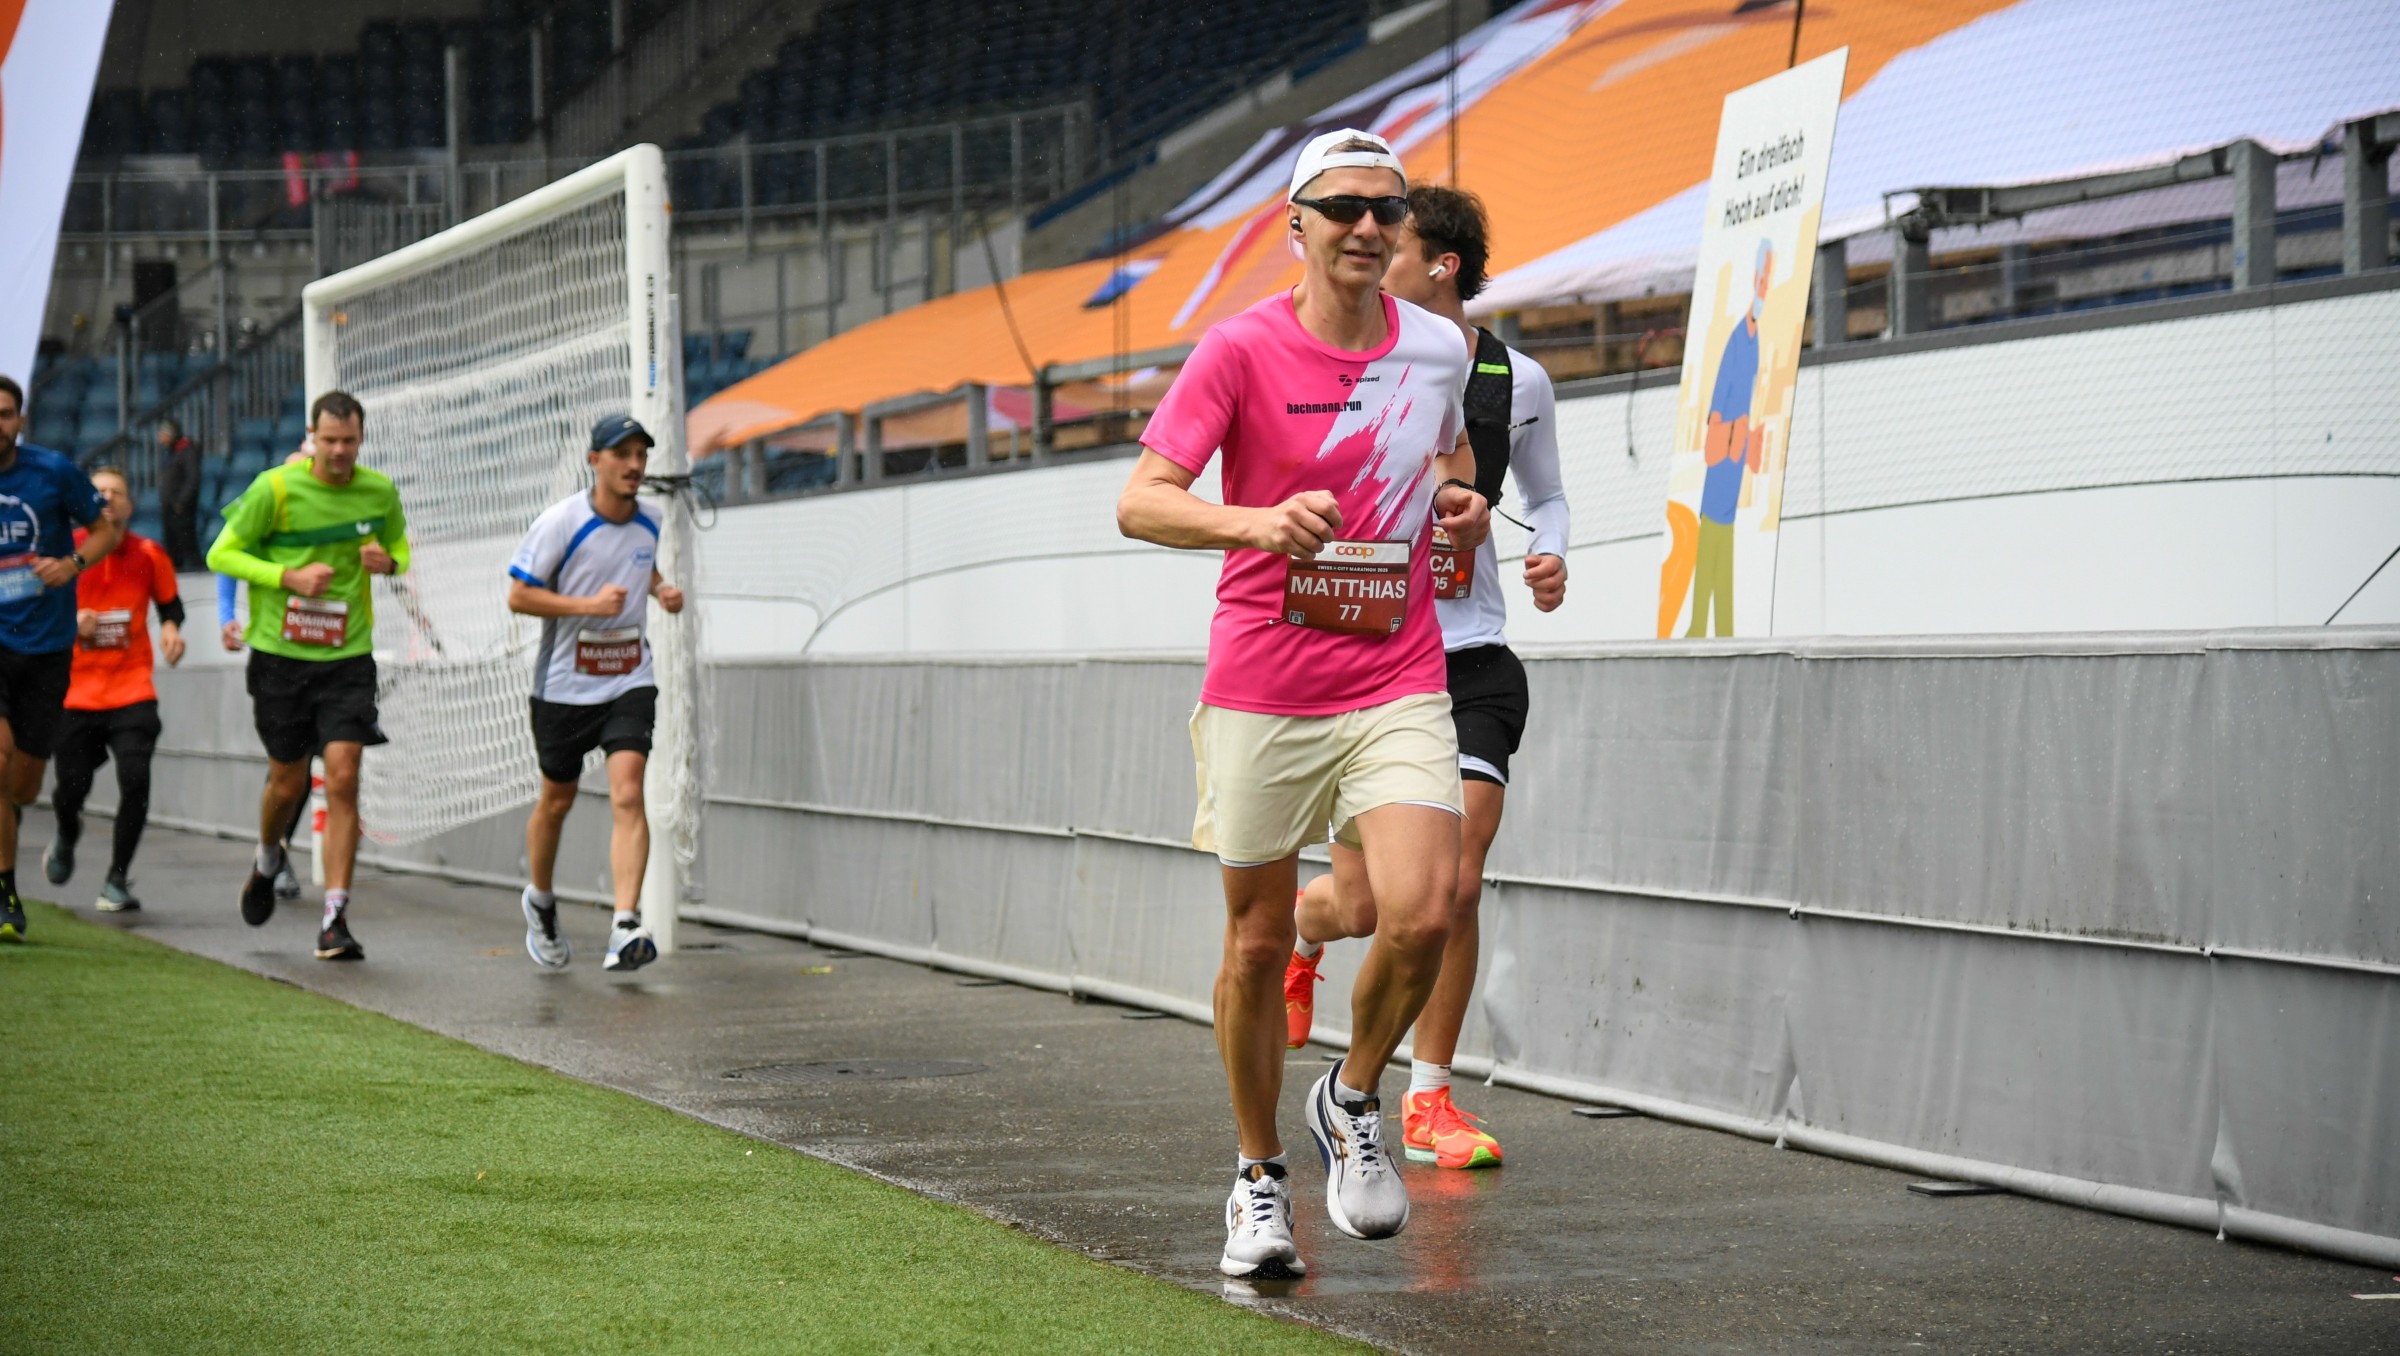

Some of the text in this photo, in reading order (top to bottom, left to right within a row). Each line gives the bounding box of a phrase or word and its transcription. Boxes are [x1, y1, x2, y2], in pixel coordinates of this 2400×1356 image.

[1737, 128, 1805, 179] Ein dreifach
[1722, 173, 1805, 228] Hoch auf dich!
[1355, 375, 1380, 383] spized
[1286, 400, 1362, 415] bachmann.run
[1335, 545, 1375, 560] coop
[1291, 575, 1406, 599] MATTHIAS
[1339, 604, 1362, 621] 77
[286, 612, 343, 631] DOMINIK
[580, 645, 638, 660] MARKUS
